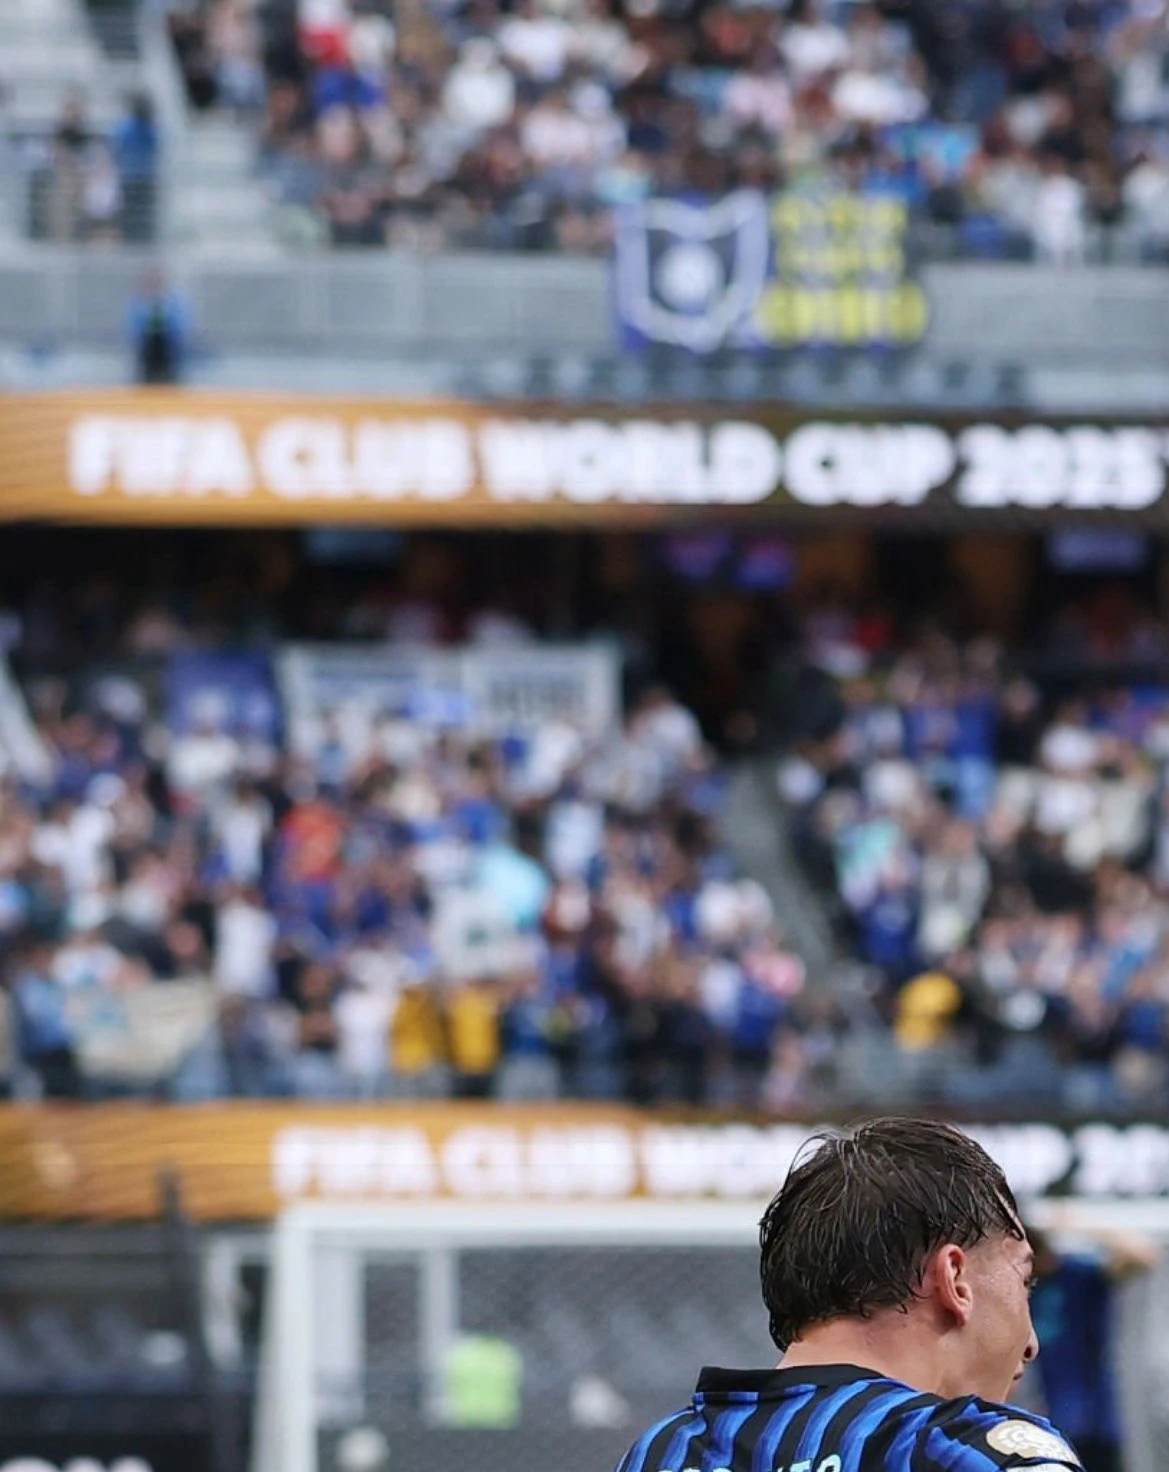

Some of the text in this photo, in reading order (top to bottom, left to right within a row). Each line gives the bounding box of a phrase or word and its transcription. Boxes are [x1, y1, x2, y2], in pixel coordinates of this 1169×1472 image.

[67, 414, 252, 497] FIFA
[256, 416, 474, 499] CLUB
[479, 418, 781, 503] WORLD
[782, 421, 956, 505] CUP
[271, 1123, 436, 1199] FIFA
[440, 1123, 637, 1199] CLUB
